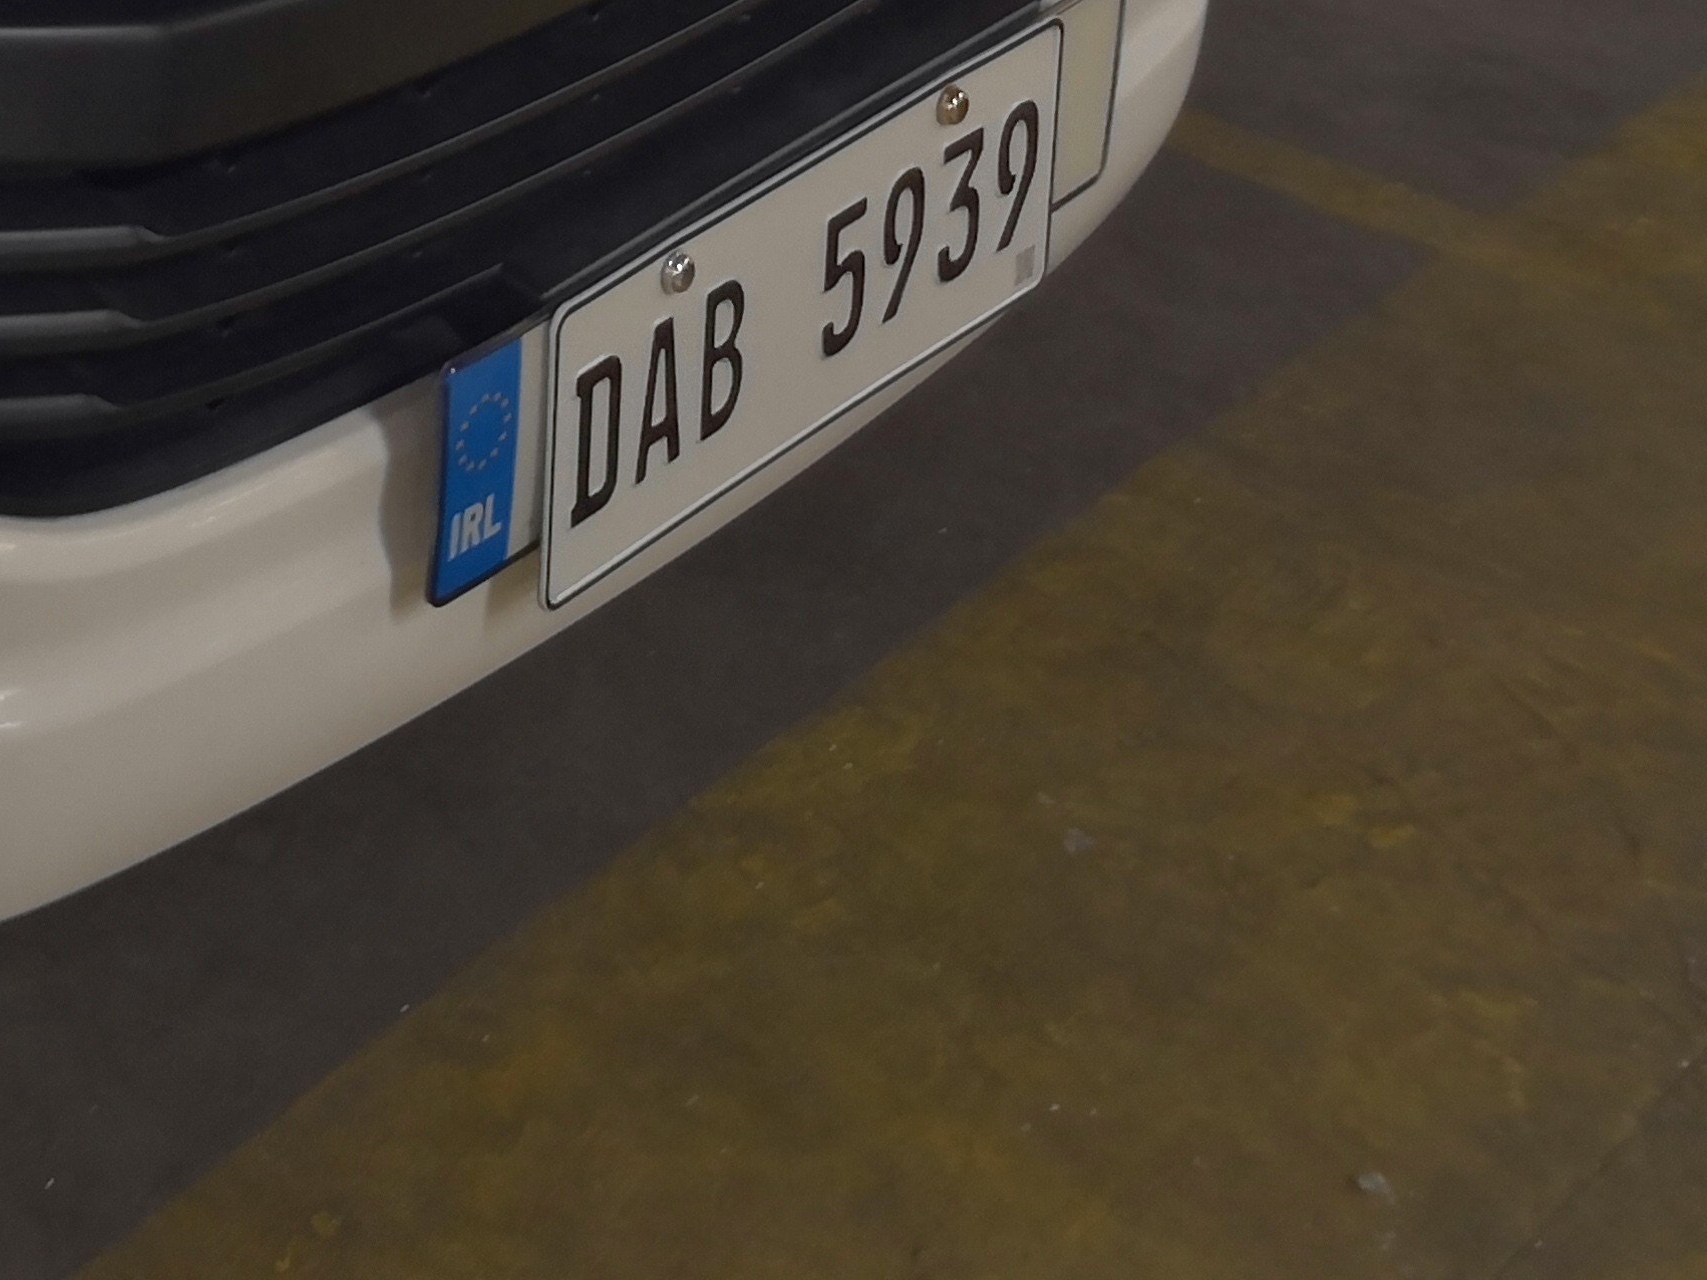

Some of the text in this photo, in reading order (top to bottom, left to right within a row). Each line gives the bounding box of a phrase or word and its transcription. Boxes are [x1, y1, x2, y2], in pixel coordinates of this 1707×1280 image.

[570, 100, 1041, 529] DAB 5939
[448, 496, 503, 562] IRL
